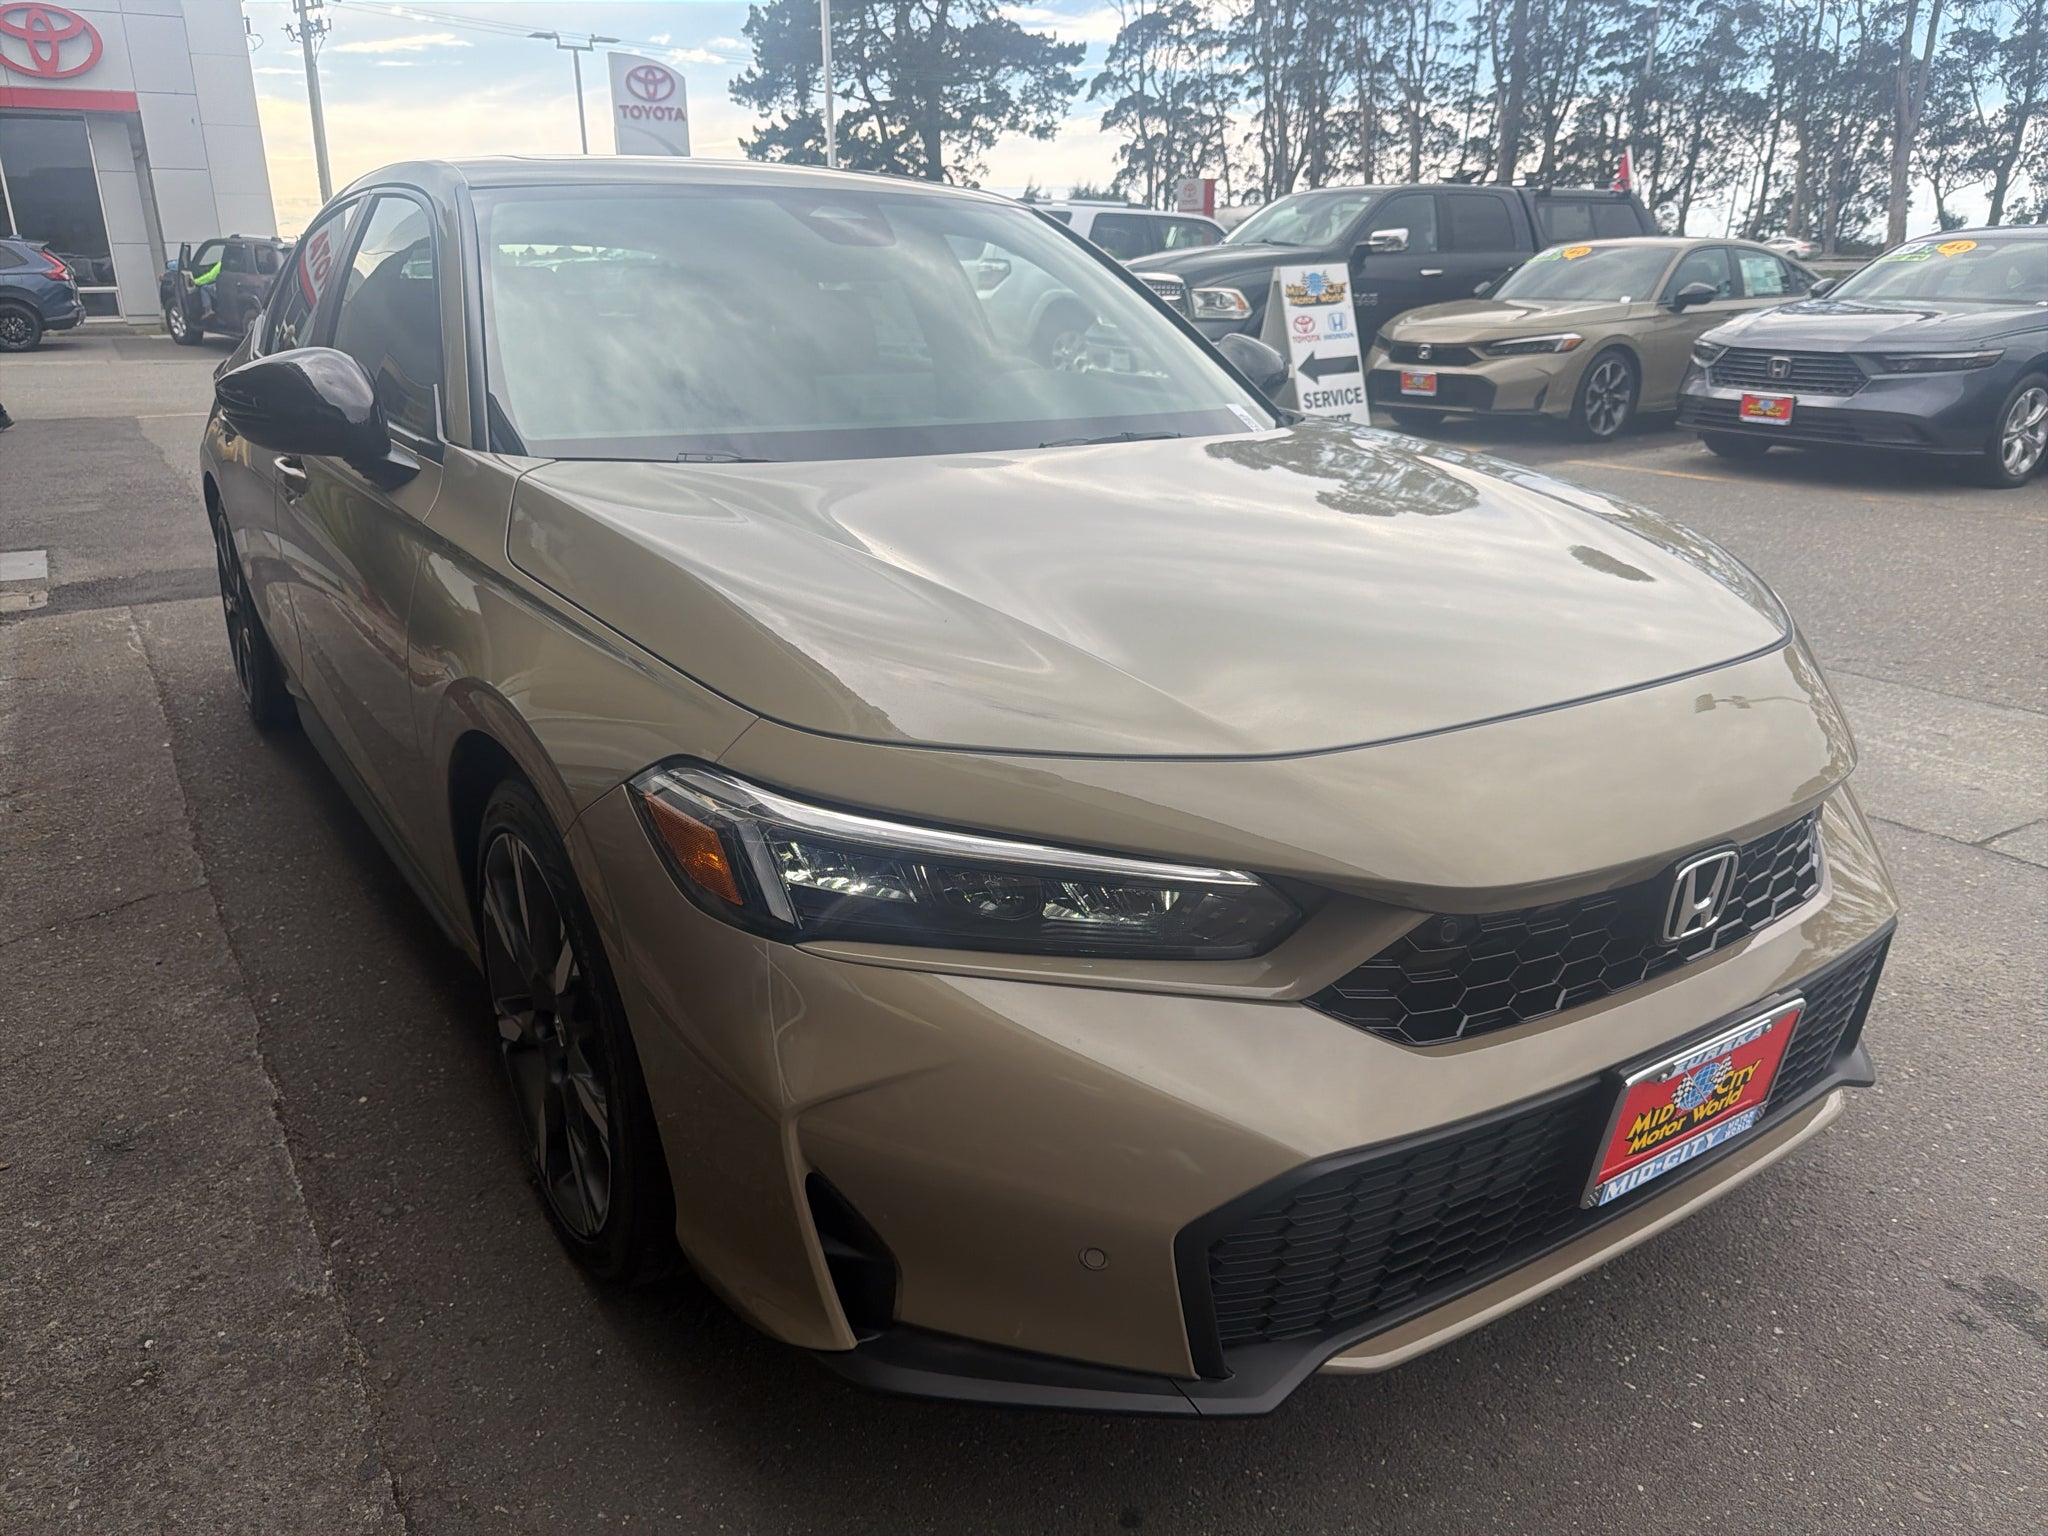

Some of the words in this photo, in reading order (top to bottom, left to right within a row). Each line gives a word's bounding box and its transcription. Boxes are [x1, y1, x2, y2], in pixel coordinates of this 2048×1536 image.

[618, 104, 687, 121] TOYOTA
[1303, 387, 1364, 410] SERVICE
[1670, 1026, 1763, 1078] EUREKA
[1626, 1103, 1676, 1140] MID
[1716, 1059, 1762, 1094] CITY
[1627, 1116, 1688, 1154] Motor
[1693, 1084, 1745, 1122] World
